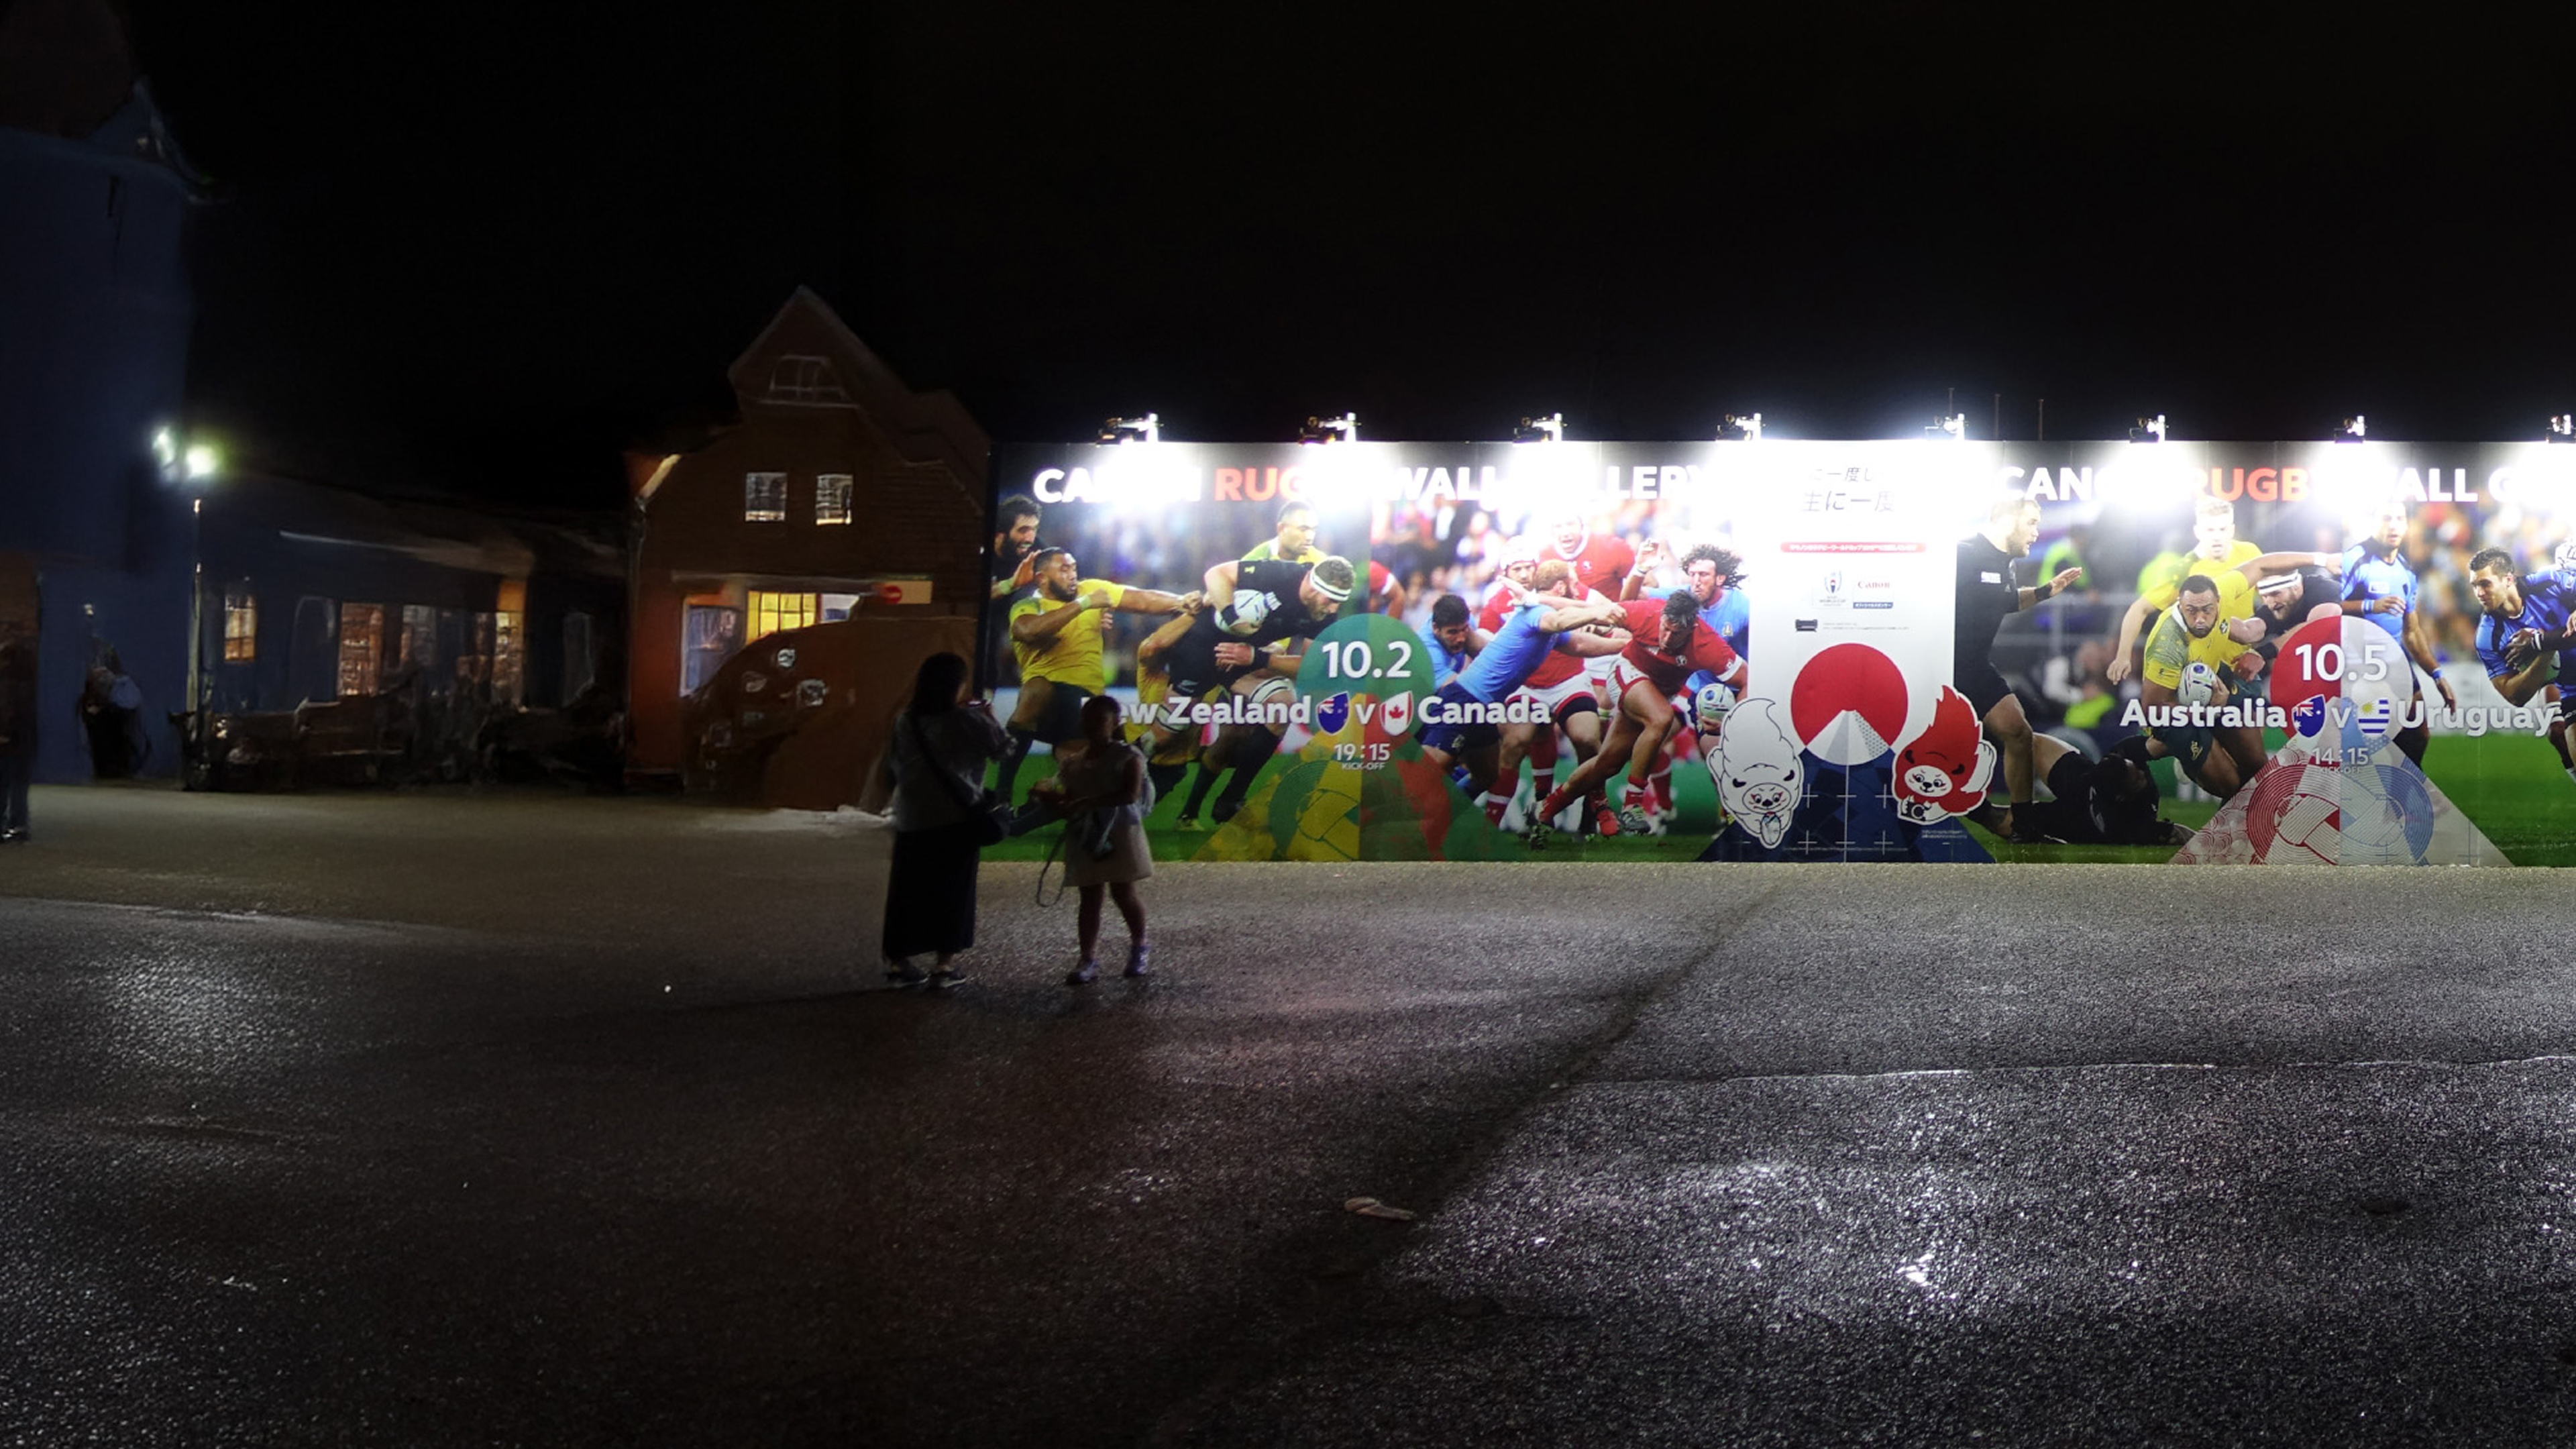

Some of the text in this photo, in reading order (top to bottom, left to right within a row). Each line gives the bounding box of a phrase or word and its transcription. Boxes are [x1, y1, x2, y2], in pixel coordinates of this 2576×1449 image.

[1858, 580, 1890, 589] Canon
[1322, 641, 1412, 679] 10.2
[2295, 643, 2387, 682] 10.5
[1168, 695, 1311, 725] Zealand
[1355, 703, 1376, 725] v
[1417, 694, 1552, 725] Canada
[2119, 698, 2555, 737] Australia v Uruguay
[1342, 762, 1386, 771] KICK-OFF
